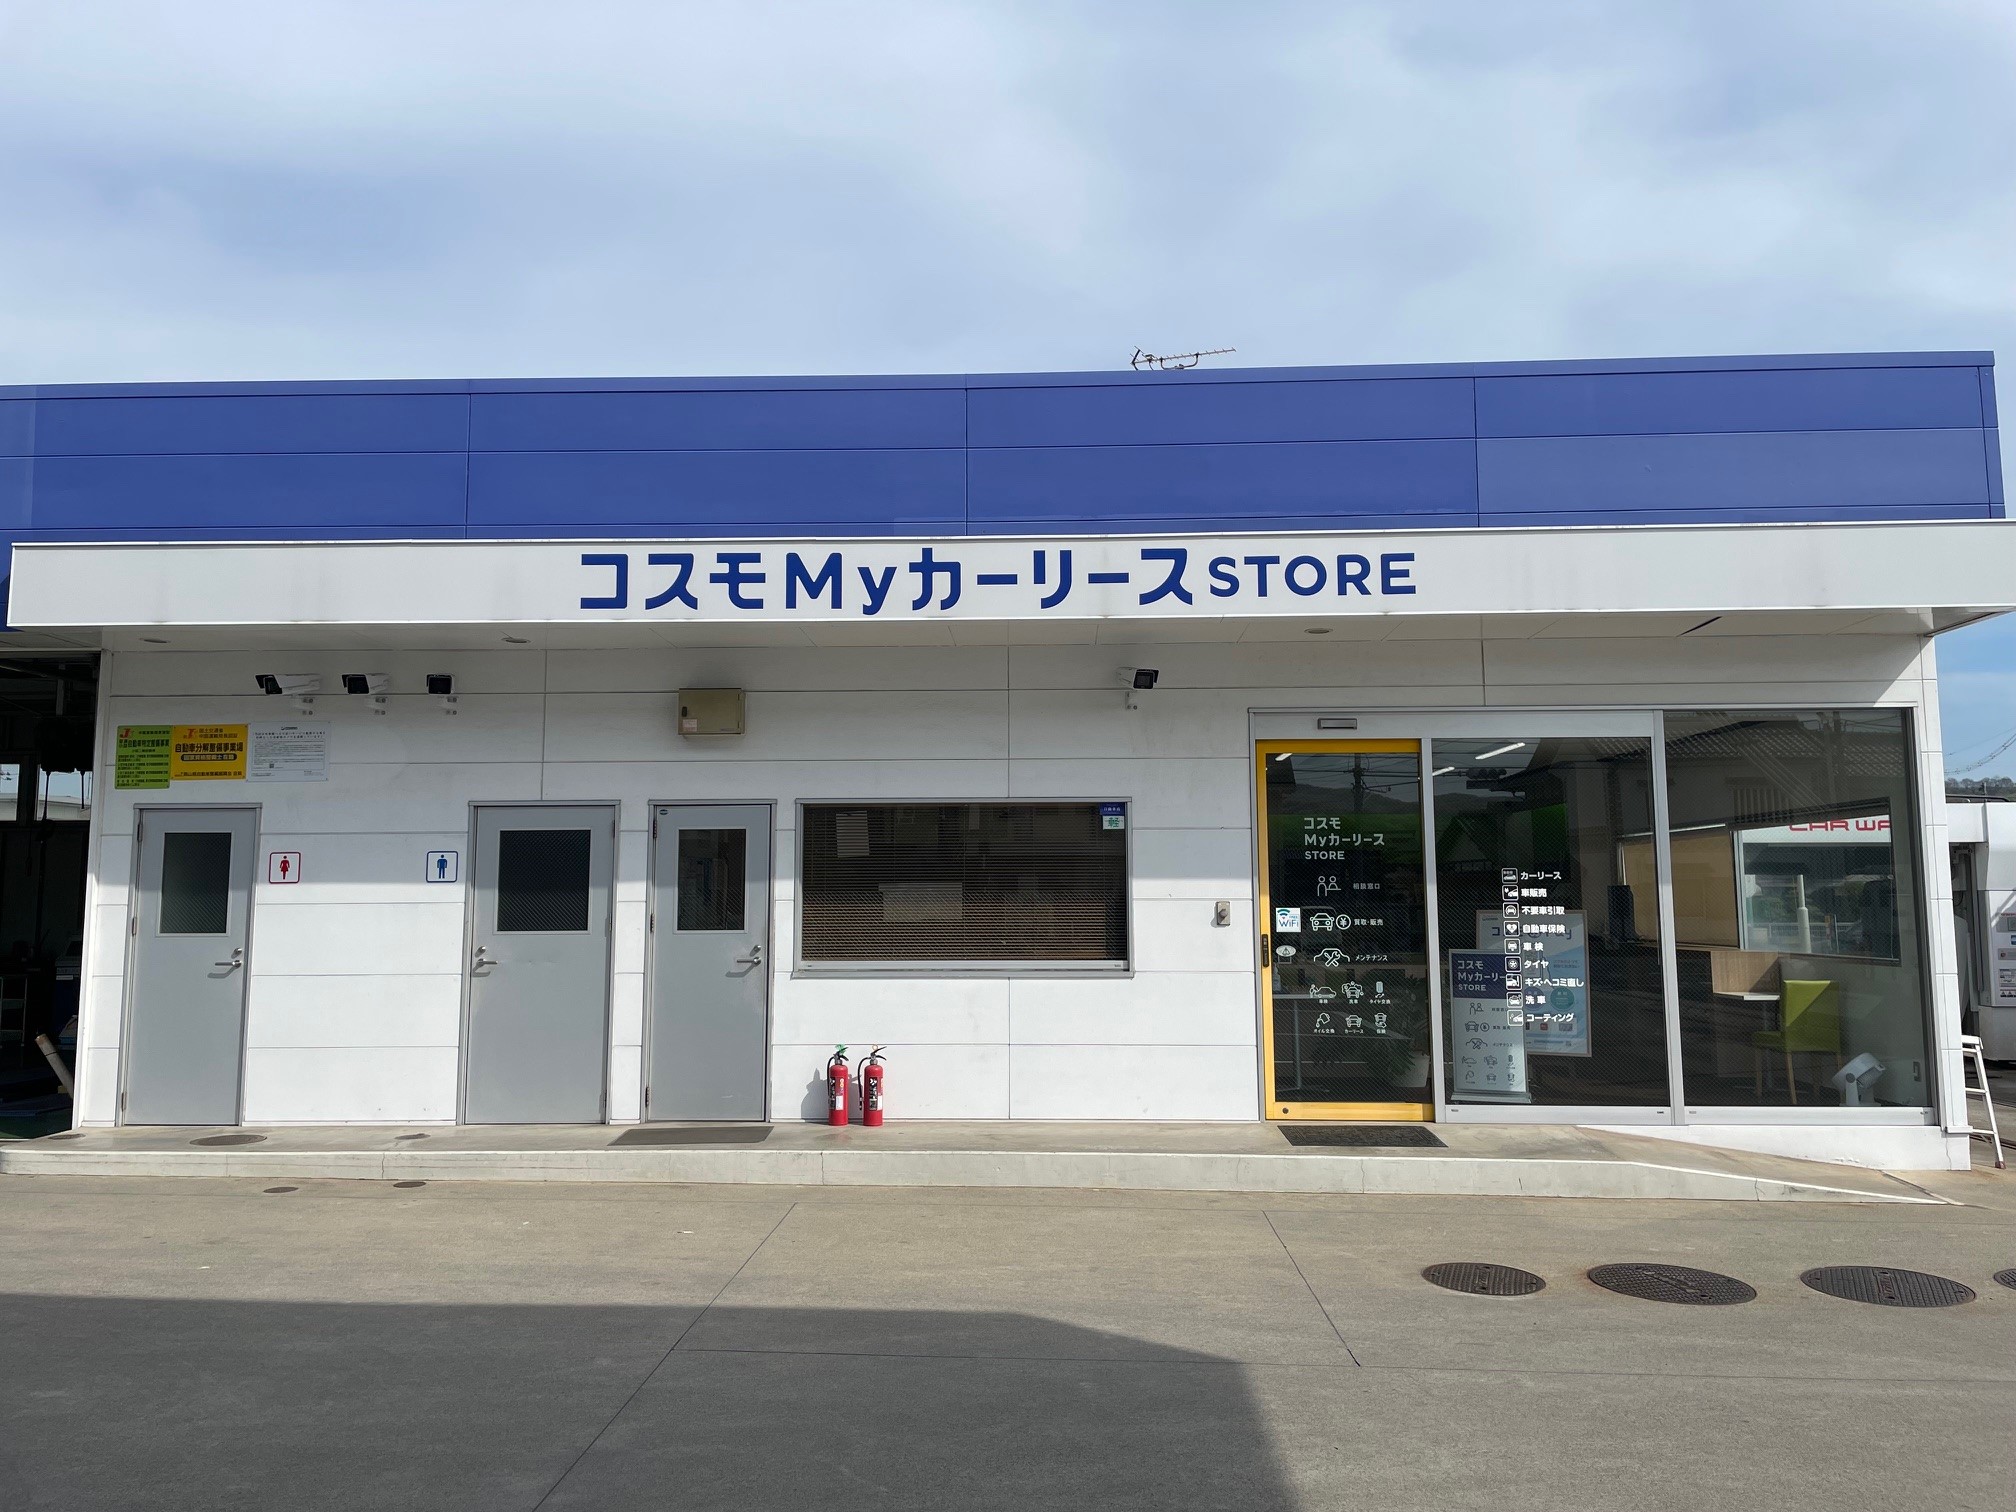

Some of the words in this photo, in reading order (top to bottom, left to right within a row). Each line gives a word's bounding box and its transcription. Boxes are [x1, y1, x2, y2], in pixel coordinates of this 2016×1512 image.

[1304, 817, 1341, 830] コスモ
[1304, 832, 1385, 847] Myカーリース
[1305, 850, 1346, 860] STORE
[1520, 872, 1562, 880] カーリース
[1353, 882, 1381, 890] 相談窓口
[1521, 888, 1548, 897] 車販売
[1521, 906, 1565, 915] 不要車引取
[1279, 919, 1299, 927] WiFi
[1522, 924, 1566, 934] 自動車保険
[1355, 954, 1388, 962] メンテナンス
[1457, 960, 1484, 970] コスモ
[1524, 960, 1549, 969] タイヤ
[1458, 972, 1508, 982] Myカーリー
[1526, 1013, 1574, 1022] コーティング
